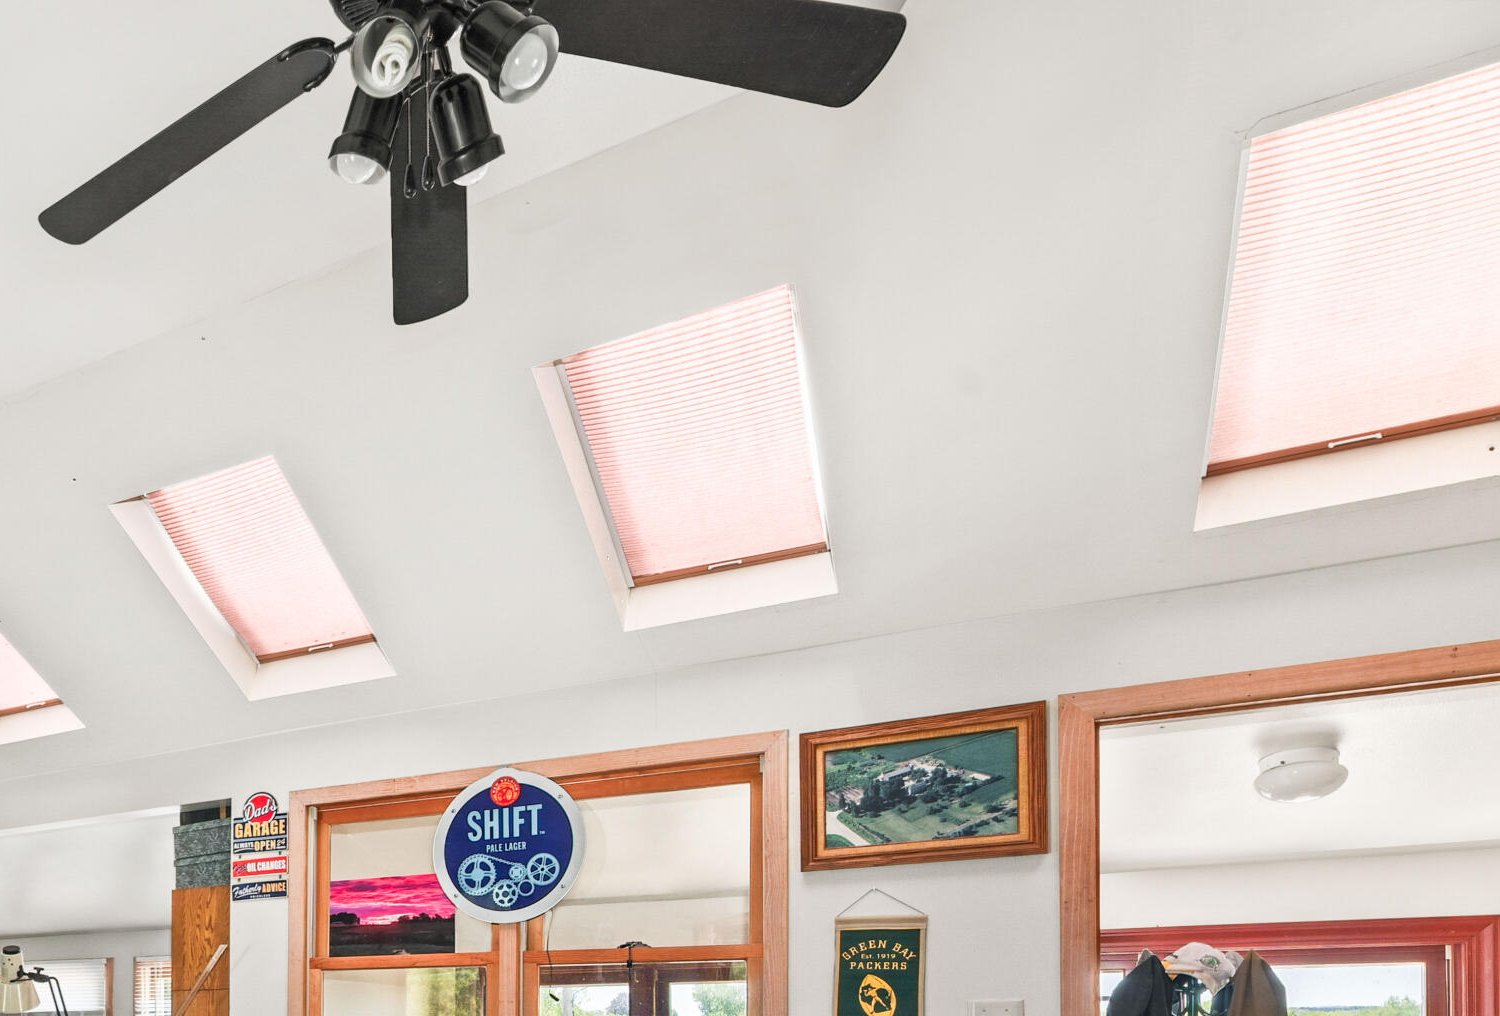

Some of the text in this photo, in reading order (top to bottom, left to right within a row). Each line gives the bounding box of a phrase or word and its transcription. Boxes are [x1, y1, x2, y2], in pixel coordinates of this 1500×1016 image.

[234, 819, 286, 839] GARAGE
[466, 803, 543, 842] SHIFT
[254, 839, 277, 851] OPEN
[486, 841, 527, 853] PALE LAGER
[246, 862, 257, 873] OIL
[257, 859, 286, 872] CHANGES
[261, 881, 287, 893] ADVICE
[842, 939, 917, 960] GREEN BAY
[849, 961, 908, 970] PACKERS
